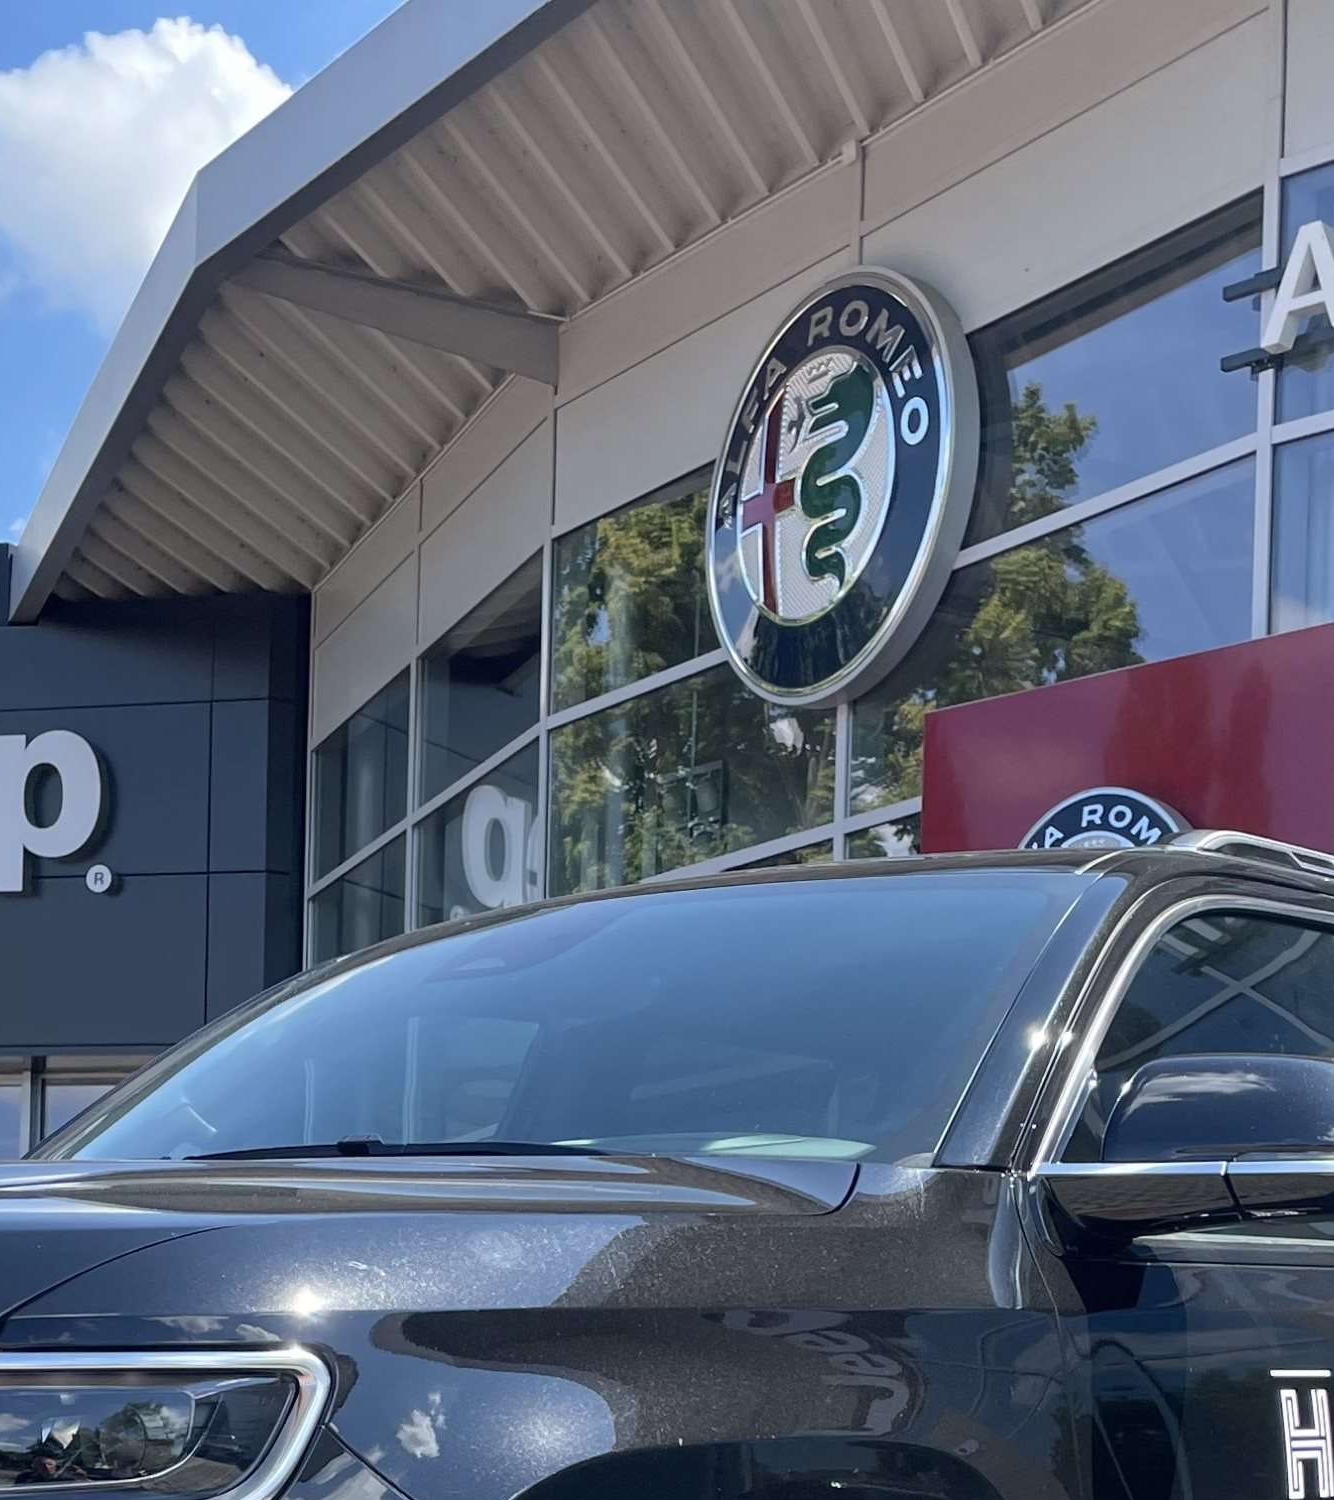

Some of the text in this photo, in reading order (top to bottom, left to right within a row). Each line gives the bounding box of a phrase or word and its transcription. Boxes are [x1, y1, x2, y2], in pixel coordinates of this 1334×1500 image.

[717, 299, 930, 530] ALFA ROMEO
[1080, 803, 1163, 846] ROM
